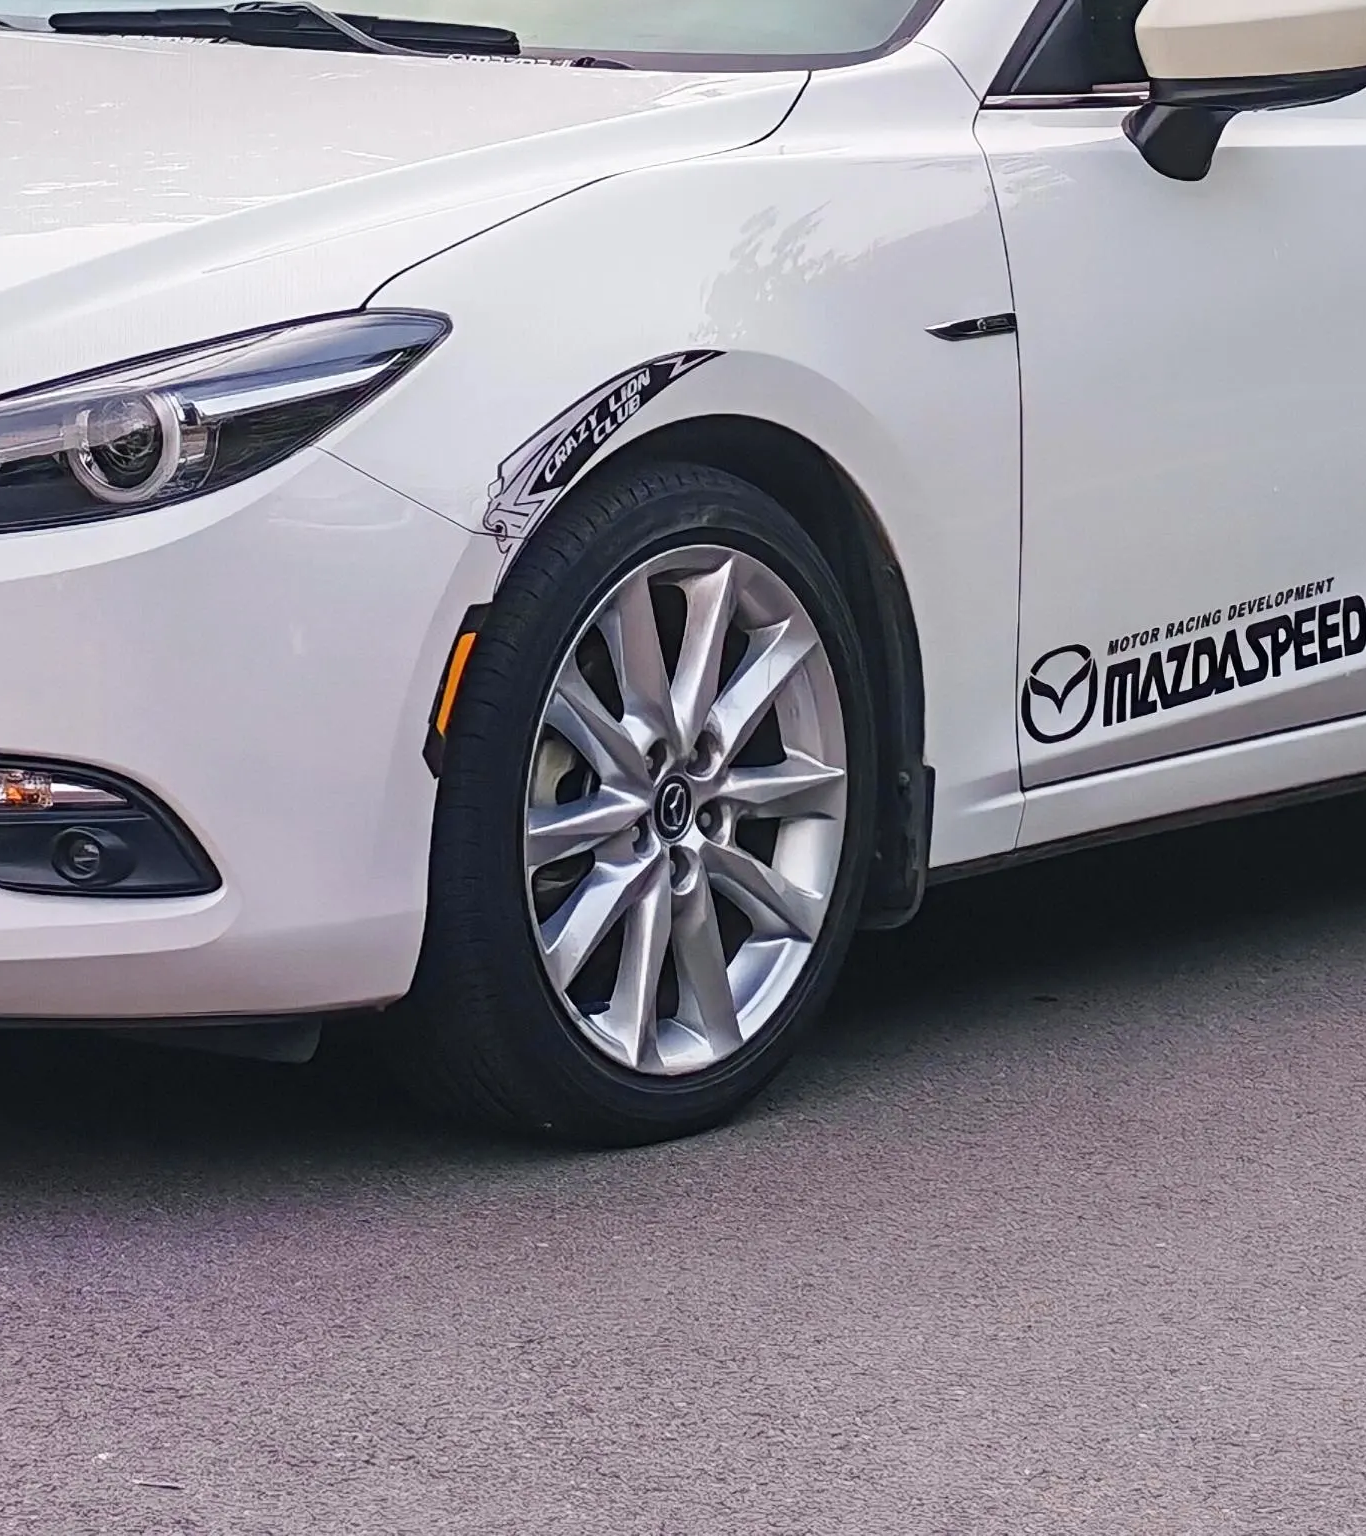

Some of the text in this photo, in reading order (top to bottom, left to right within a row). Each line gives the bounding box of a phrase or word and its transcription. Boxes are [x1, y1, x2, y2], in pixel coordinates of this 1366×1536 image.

[544, 368, 651, 483] CRAZY LION
[593, 394, 641, 444] CLUB
[1107, 577, 1335, 656] MOTOR RACING DEVELOPMENT
